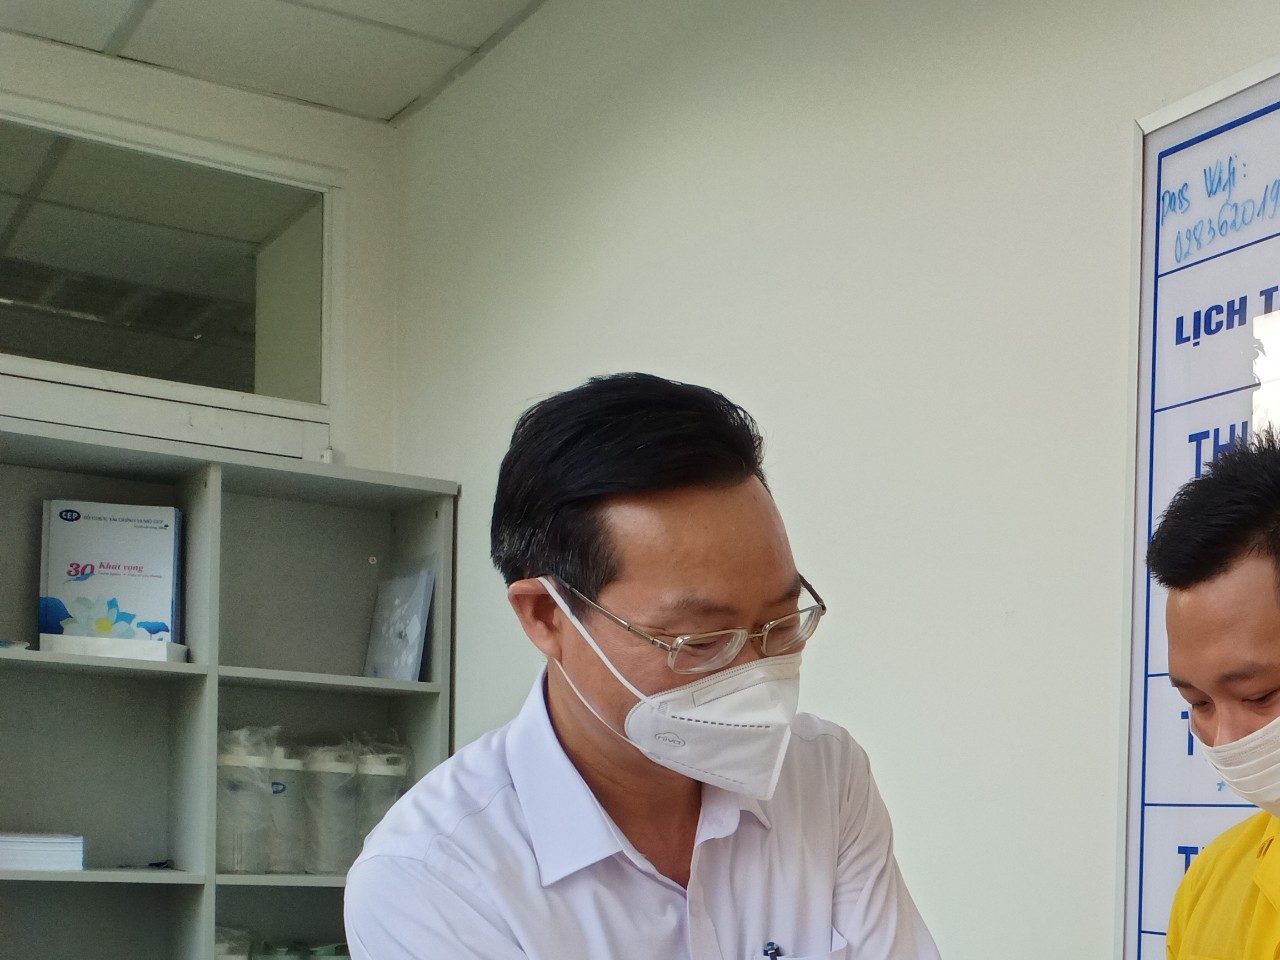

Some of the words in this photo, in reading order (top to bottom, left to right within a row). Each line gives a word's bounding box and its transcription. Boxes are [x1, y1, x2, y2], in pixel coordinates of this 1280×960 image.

[1175, 295, 1248, 348] LỊCH
[1188, 420, 1249, 479] TH
[67, 562, 95, 577] 30
